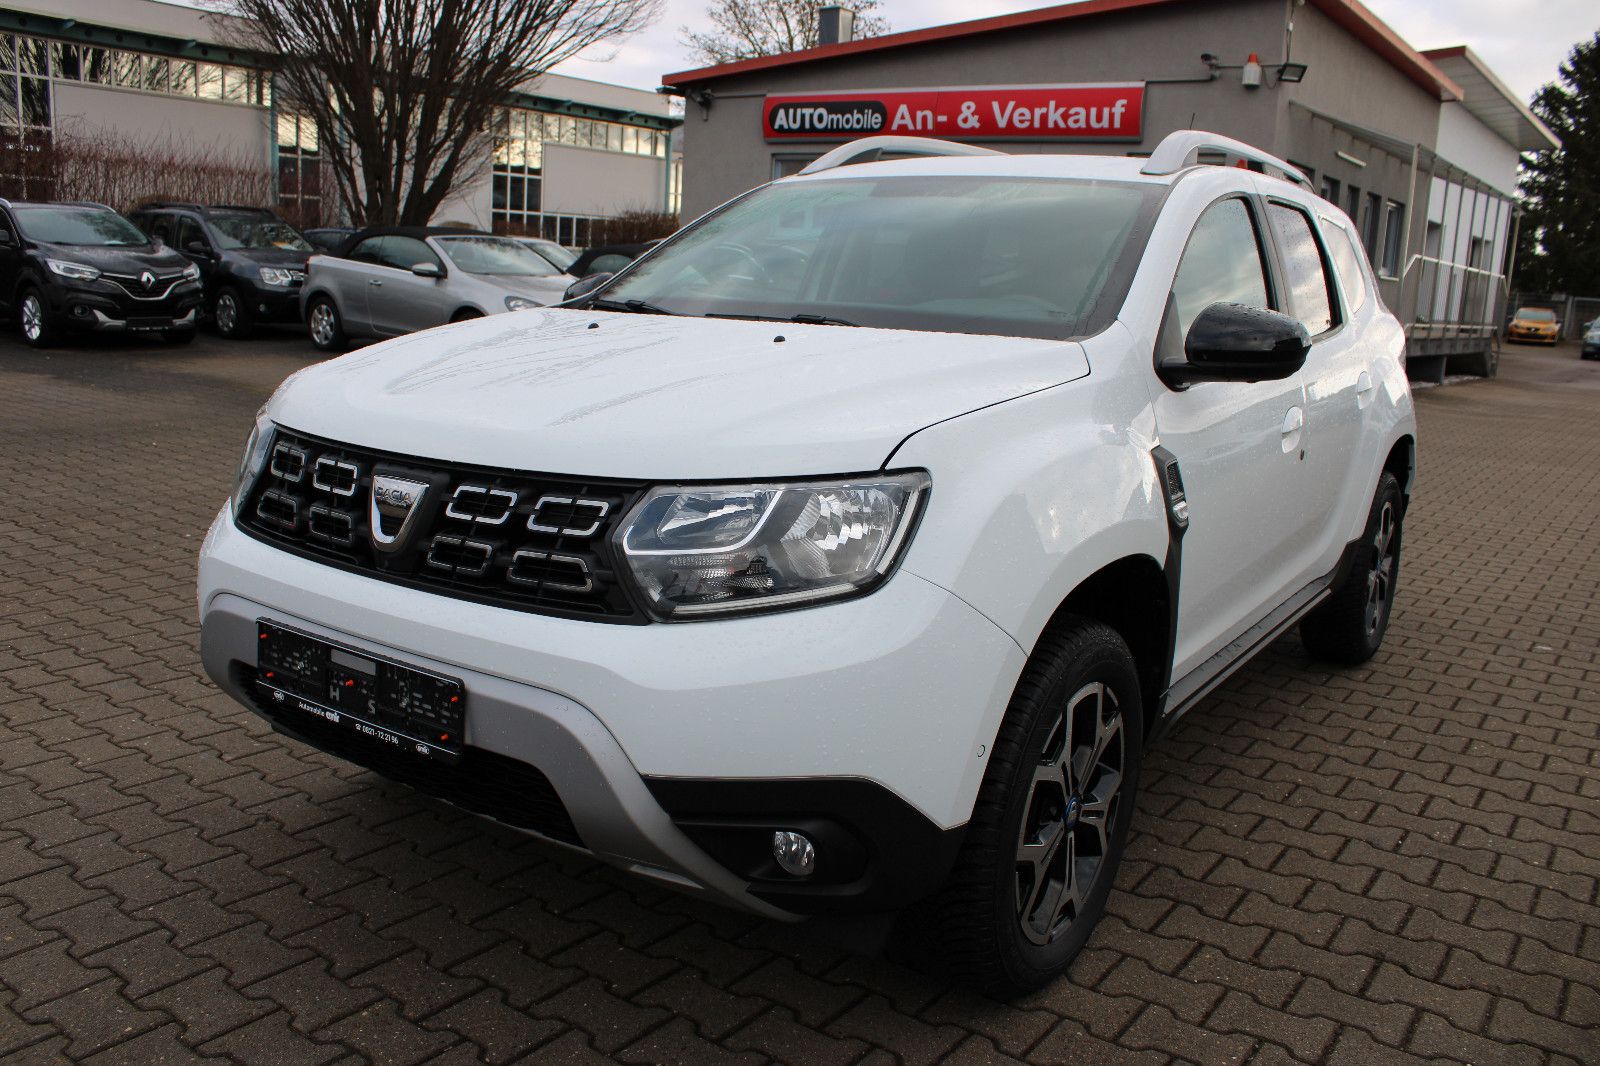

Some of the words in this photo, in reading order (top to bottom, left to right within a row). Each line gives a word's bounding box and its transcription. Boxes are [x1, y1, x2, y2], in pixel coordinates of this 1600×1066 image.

[774, 107, 882, 131] AUTOmobile
[891, 104, 947, 131] An-
[956, 101, 980, 129] &
[991, 99, 1128, 130] Verkauf
